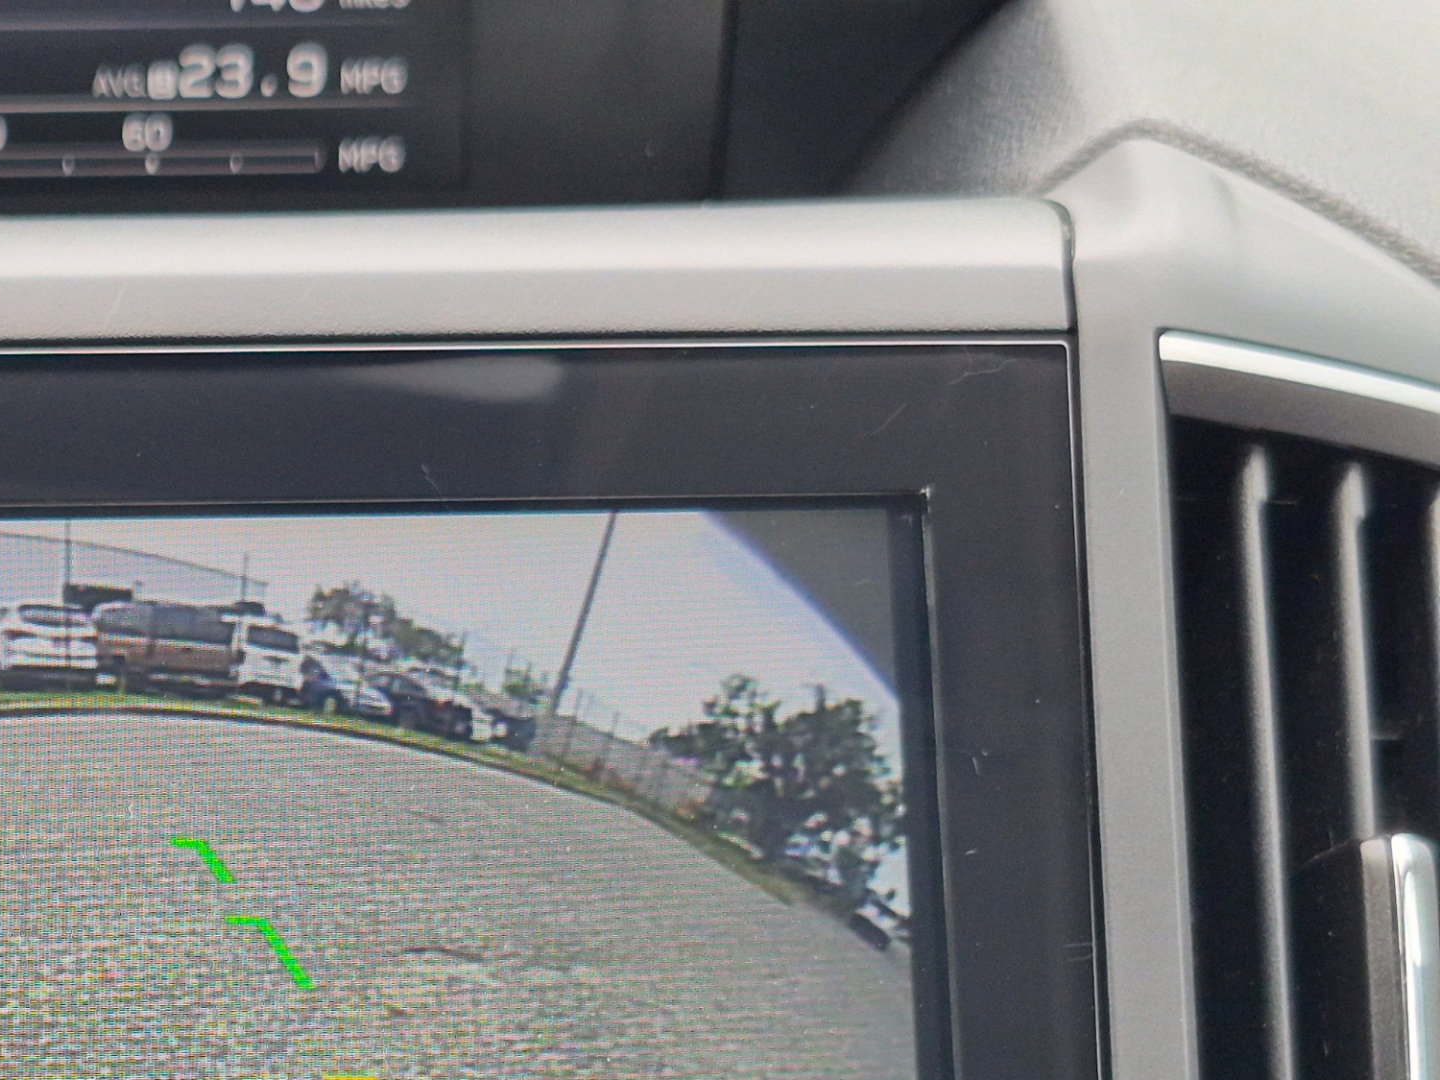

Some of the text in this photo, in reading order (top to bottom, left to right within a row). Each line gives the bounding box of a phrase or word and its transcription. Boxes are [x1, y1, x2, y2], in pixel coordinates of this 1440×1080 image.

[178, 43, 328, 99] 23.9
[339, 58, 408, 94] MPG
[121, 112, 172, 151] 60
[338, 136, 405, 172] MPG
